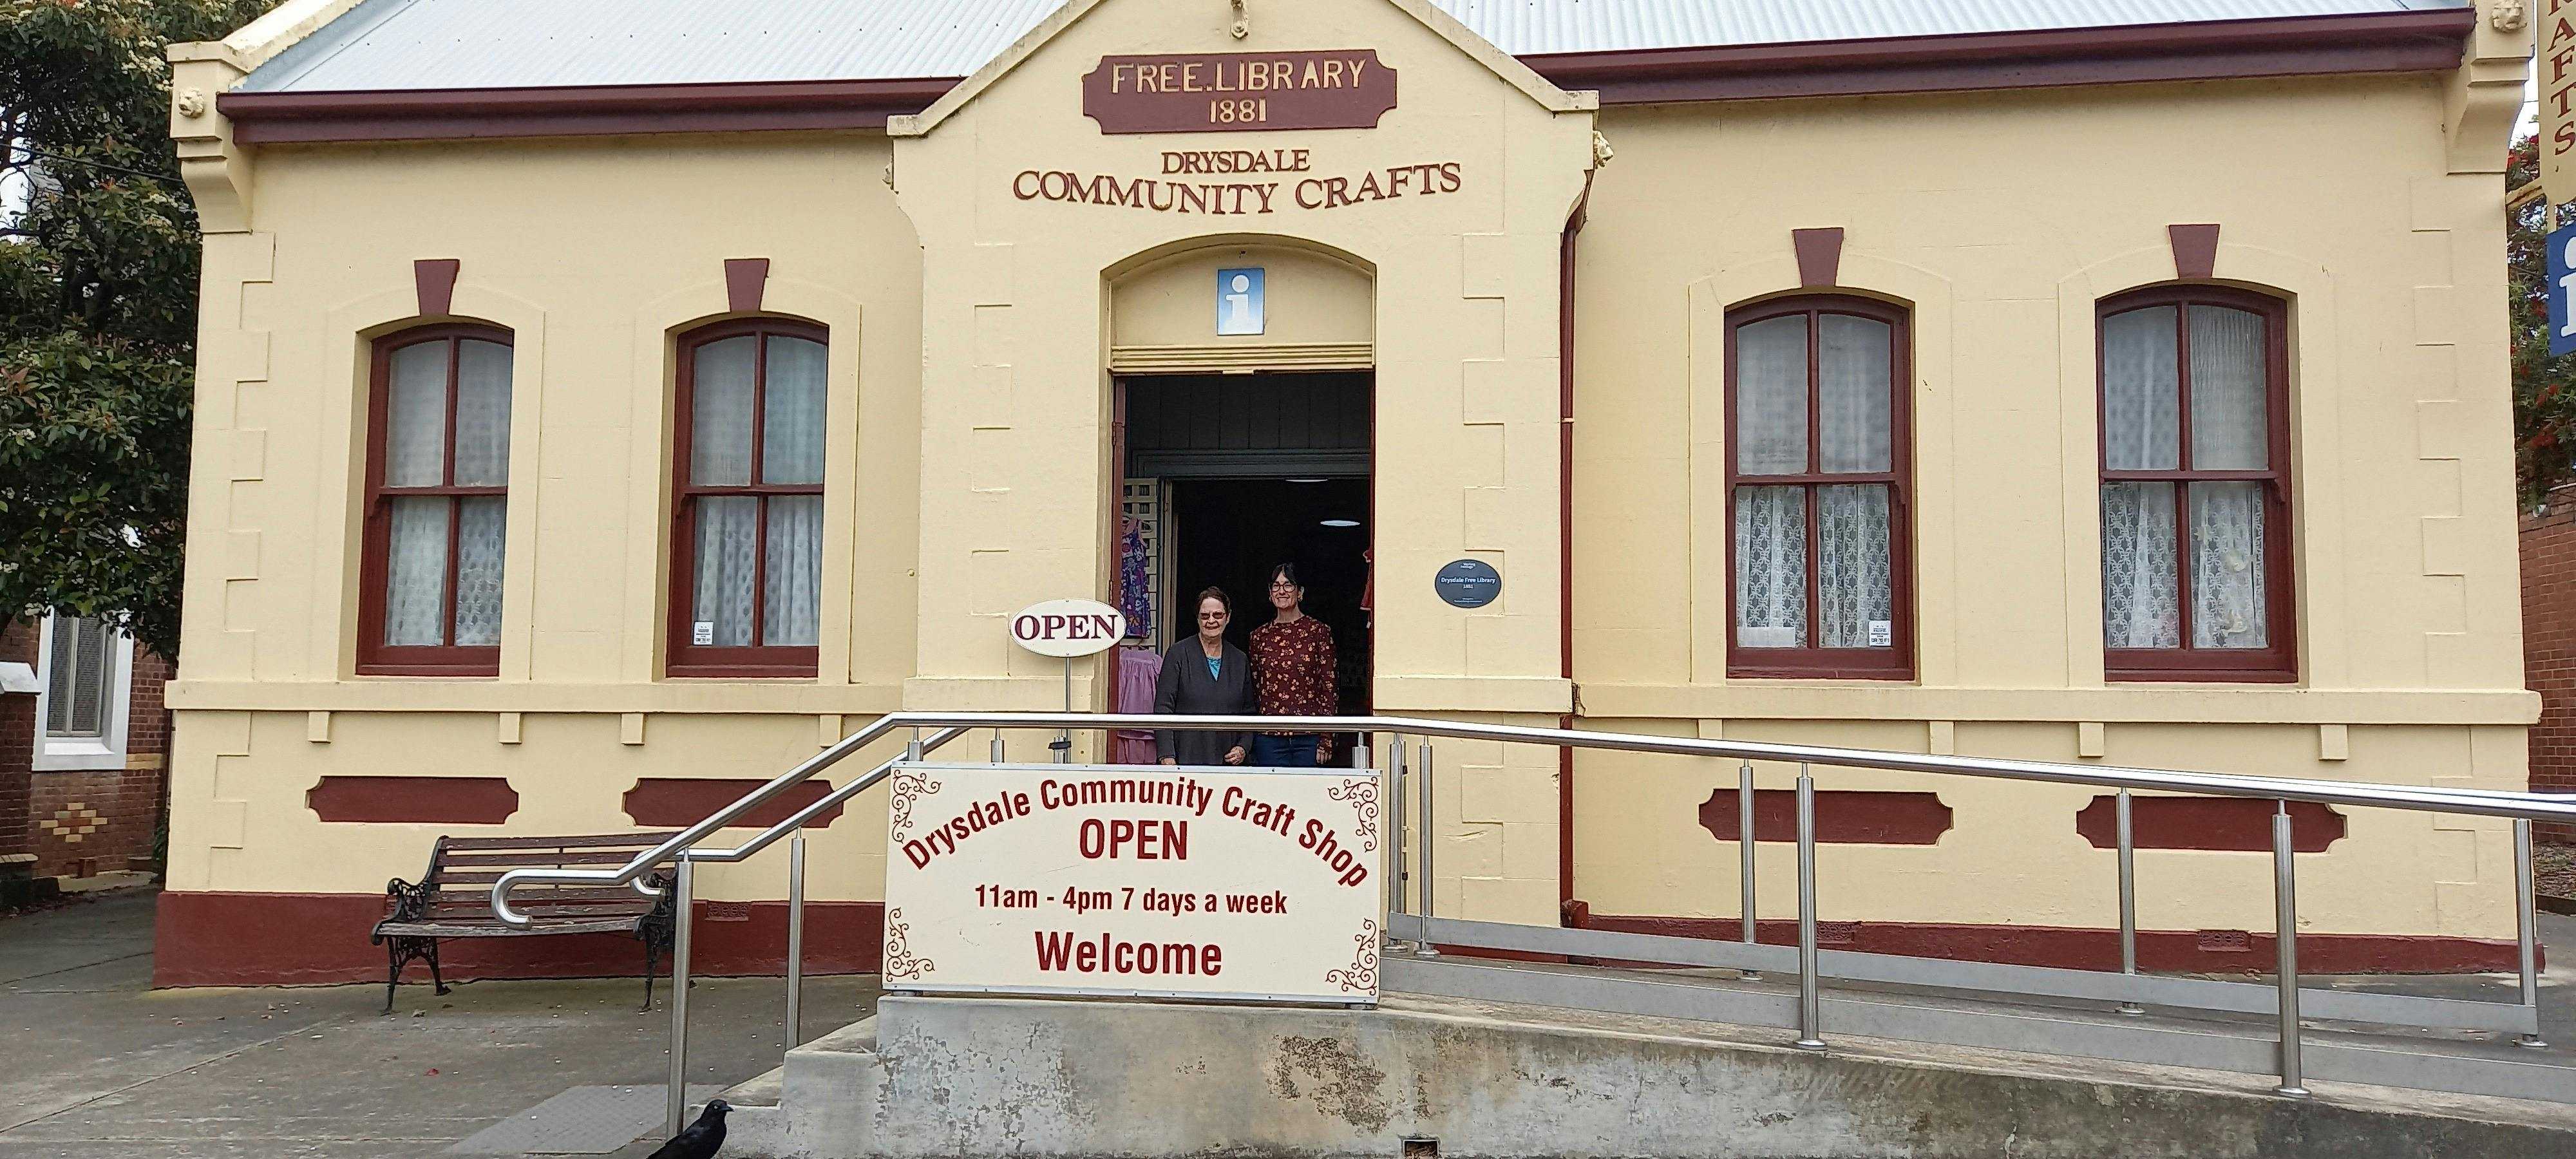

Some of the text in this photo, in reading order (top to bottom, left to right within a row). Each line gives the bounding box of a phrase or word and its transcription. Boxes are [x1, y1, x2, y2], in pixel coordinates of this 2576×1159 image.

[2546, 0, 2576, 156] AFTS
[1209, 98, 1267, 124] 1881
[1160, 149, 1311, 175] DRYSDALE
[1013, 162, 1462, 215] COMMUNITY CRAFTS
[1014, 615, 1119, 641] OPEN
[902, 776, 1368, 889] Drysdale Community Craft Shop
[1079, 818, 1189, 860] OPEN
[974, 884, 1038, 909] 11am
[1062, 887, 1113, 915] 4pm
[1121, 888, 1135, 910] 7
[1143, 888, 1196, 918] days
[1204, 894, 1217, 912] a
[1226, 890, 1288, 914] week
[1034, 930, 1223, 977] Welcome
